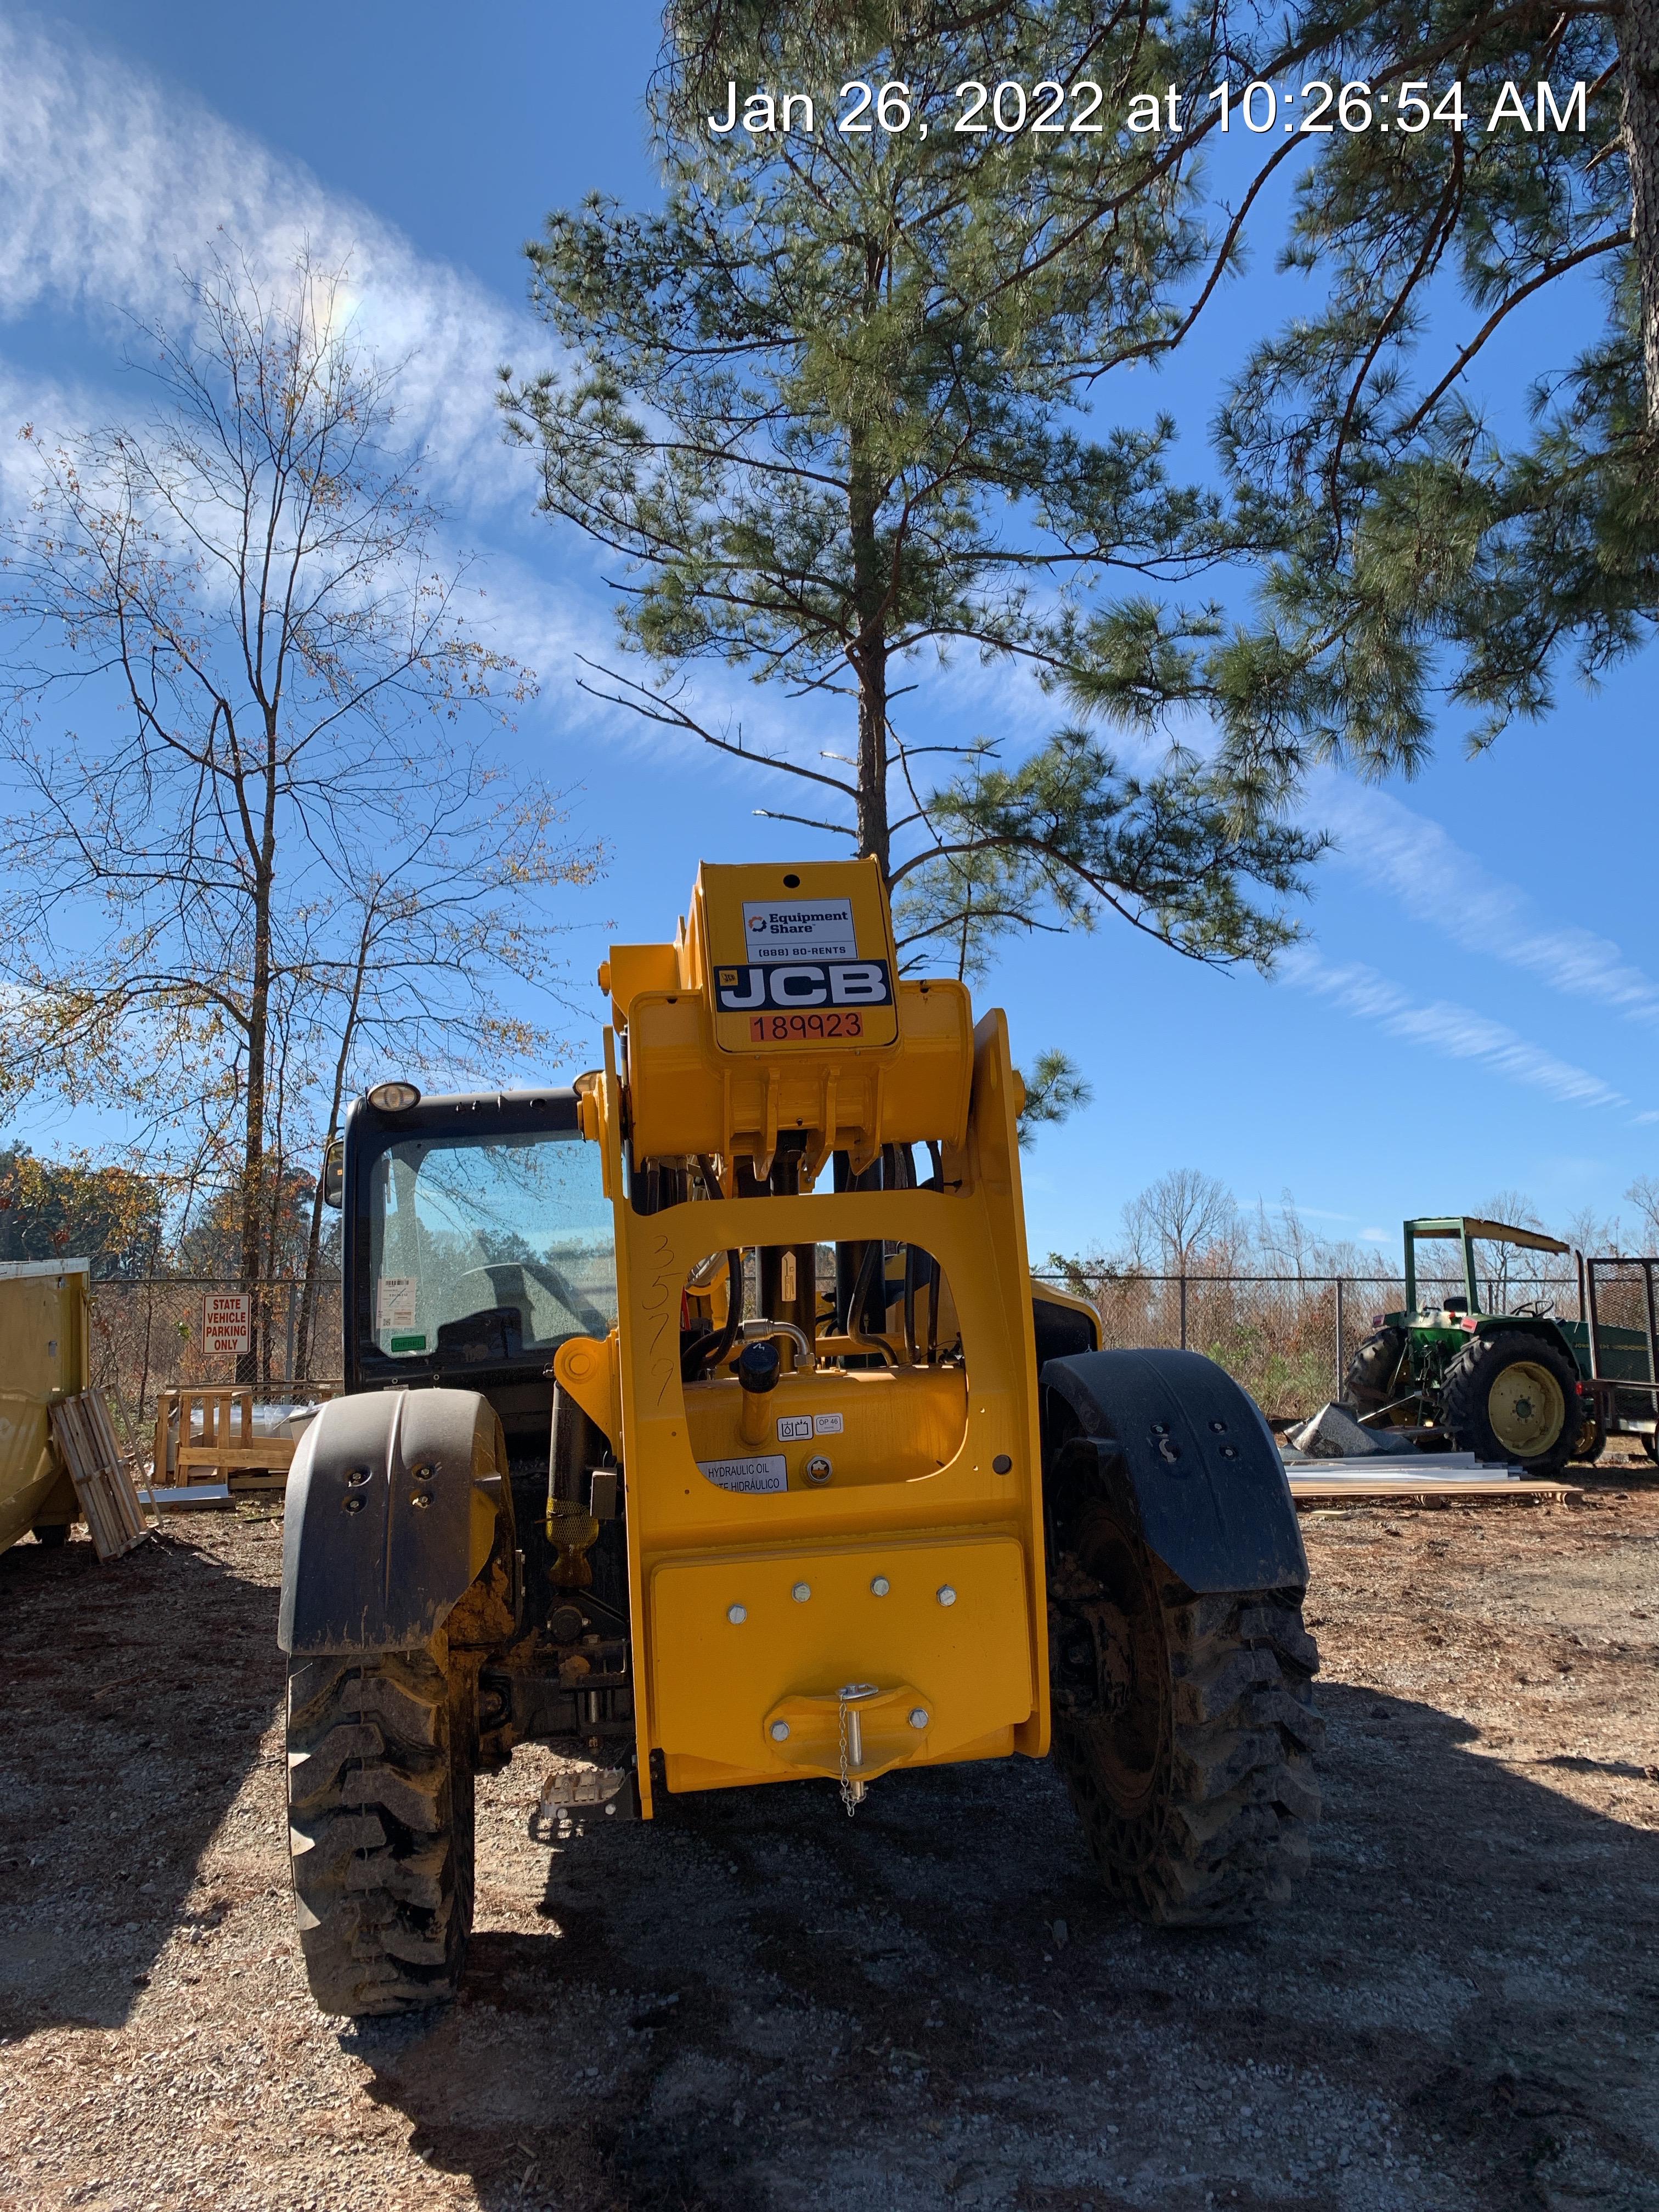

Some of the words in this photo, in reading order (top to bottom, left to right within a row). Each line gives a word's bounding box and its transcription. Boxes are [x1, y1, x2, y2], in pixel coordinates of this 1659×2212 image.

[769, 911, 848, 924] Equipment
[770, 924, 813, 934] Share
[758, 947, 789, 957] (888)
[793, 946, 846, 955] 80-RENTS
[720, 964, 887, 1008] JCB
[753, 1013, 861, 1041] 189923
[213, 1299, 241, 1310] STATE
[207, 1312, 246, 1324] VEHICLE
[206, 1325, 246, 1337] PARKING
[214, 1339, 238, 1351] ONLY
[708, 1464, 754, 1478] HYDRAULIC
[756, 1463, 769, 1474] OIL
[731, 1478, 780, 1492] HIDRÁULICO
